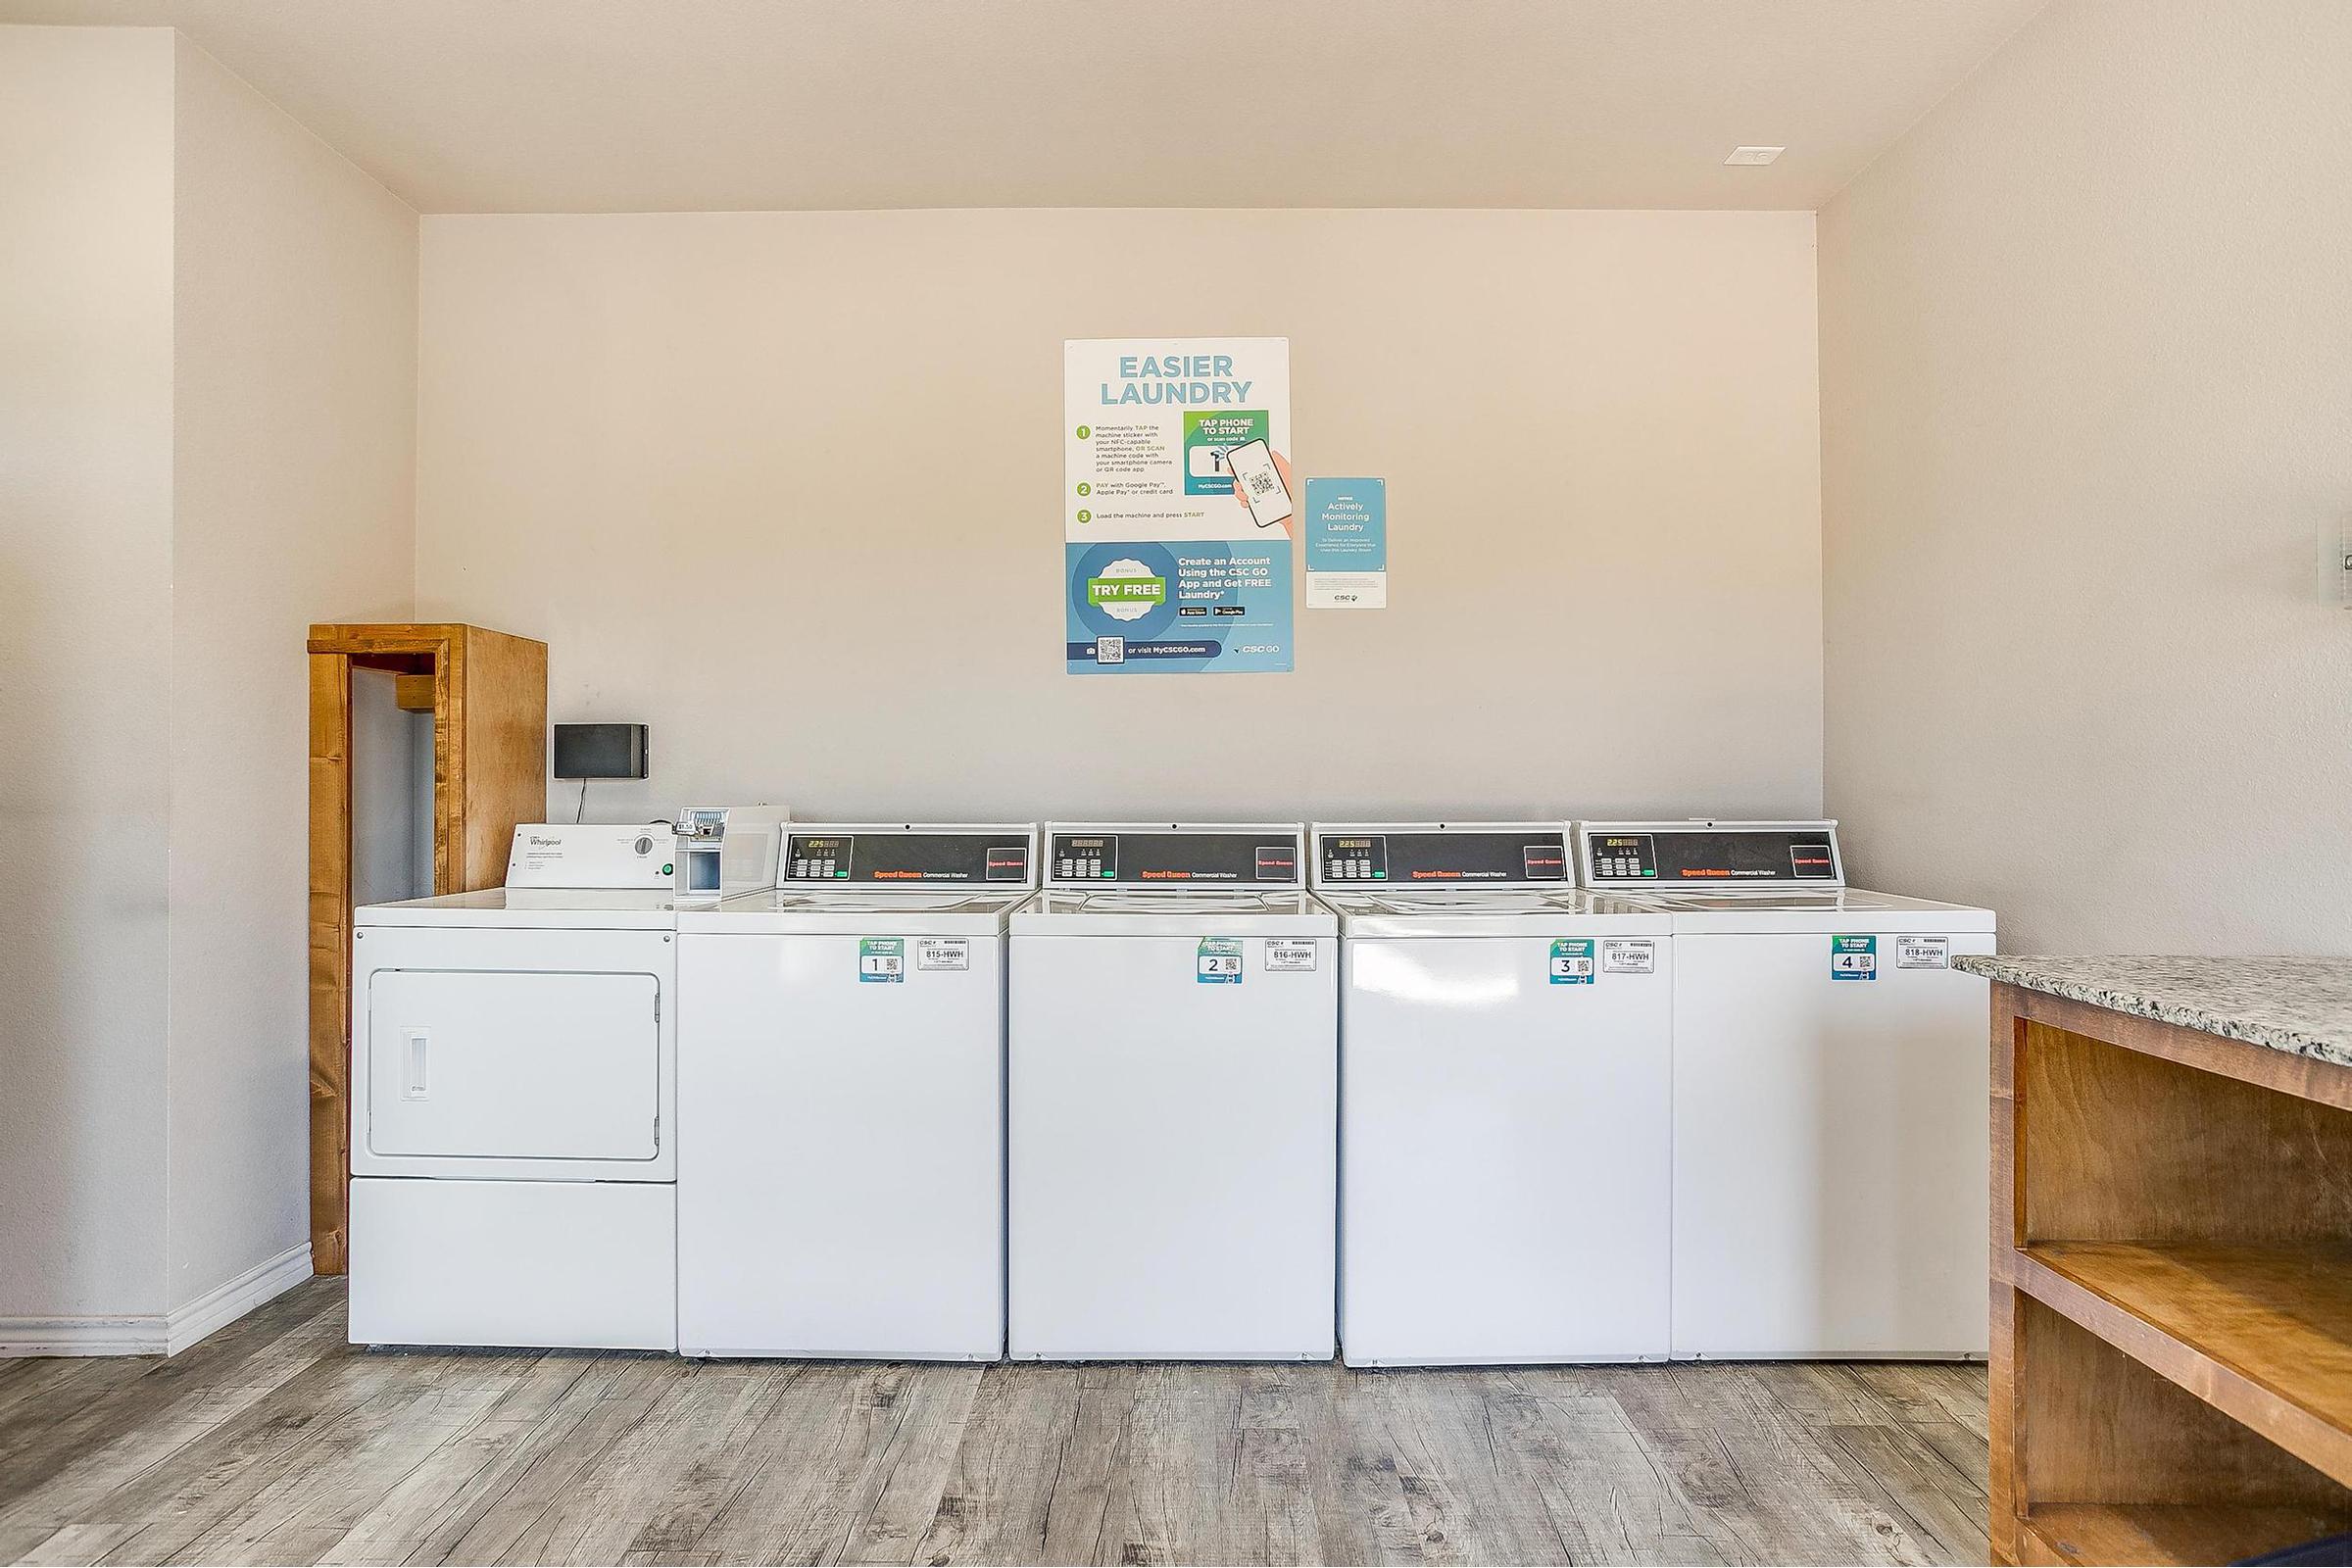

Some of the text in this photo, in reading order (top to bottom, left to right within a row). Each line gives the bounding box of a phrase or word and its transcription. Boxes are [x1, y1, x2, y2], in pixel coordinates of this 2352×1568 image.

[1120, 356, 1233, 377] EASIER
[1102, 381, 1252, 405] LAUNDRY
[1179, 558, 1211, 566] Create
[1179, 568, 1206, 577] Using
[1093, 584, 1160, 596] TRY FREE
[1179, 579, 1200, 589] App
[1202, 579, 1221, 588] and
[1153, 645, 1205, 654] MyCSCGO.com
[530, 838, 562, 847] Whirlpool
[872, 958, 877, 971] 1
[1208, 959, 1218, 971] 2
[1561, 960, 1570, 972] 3
[1842, 956, 1852, 968] 4
